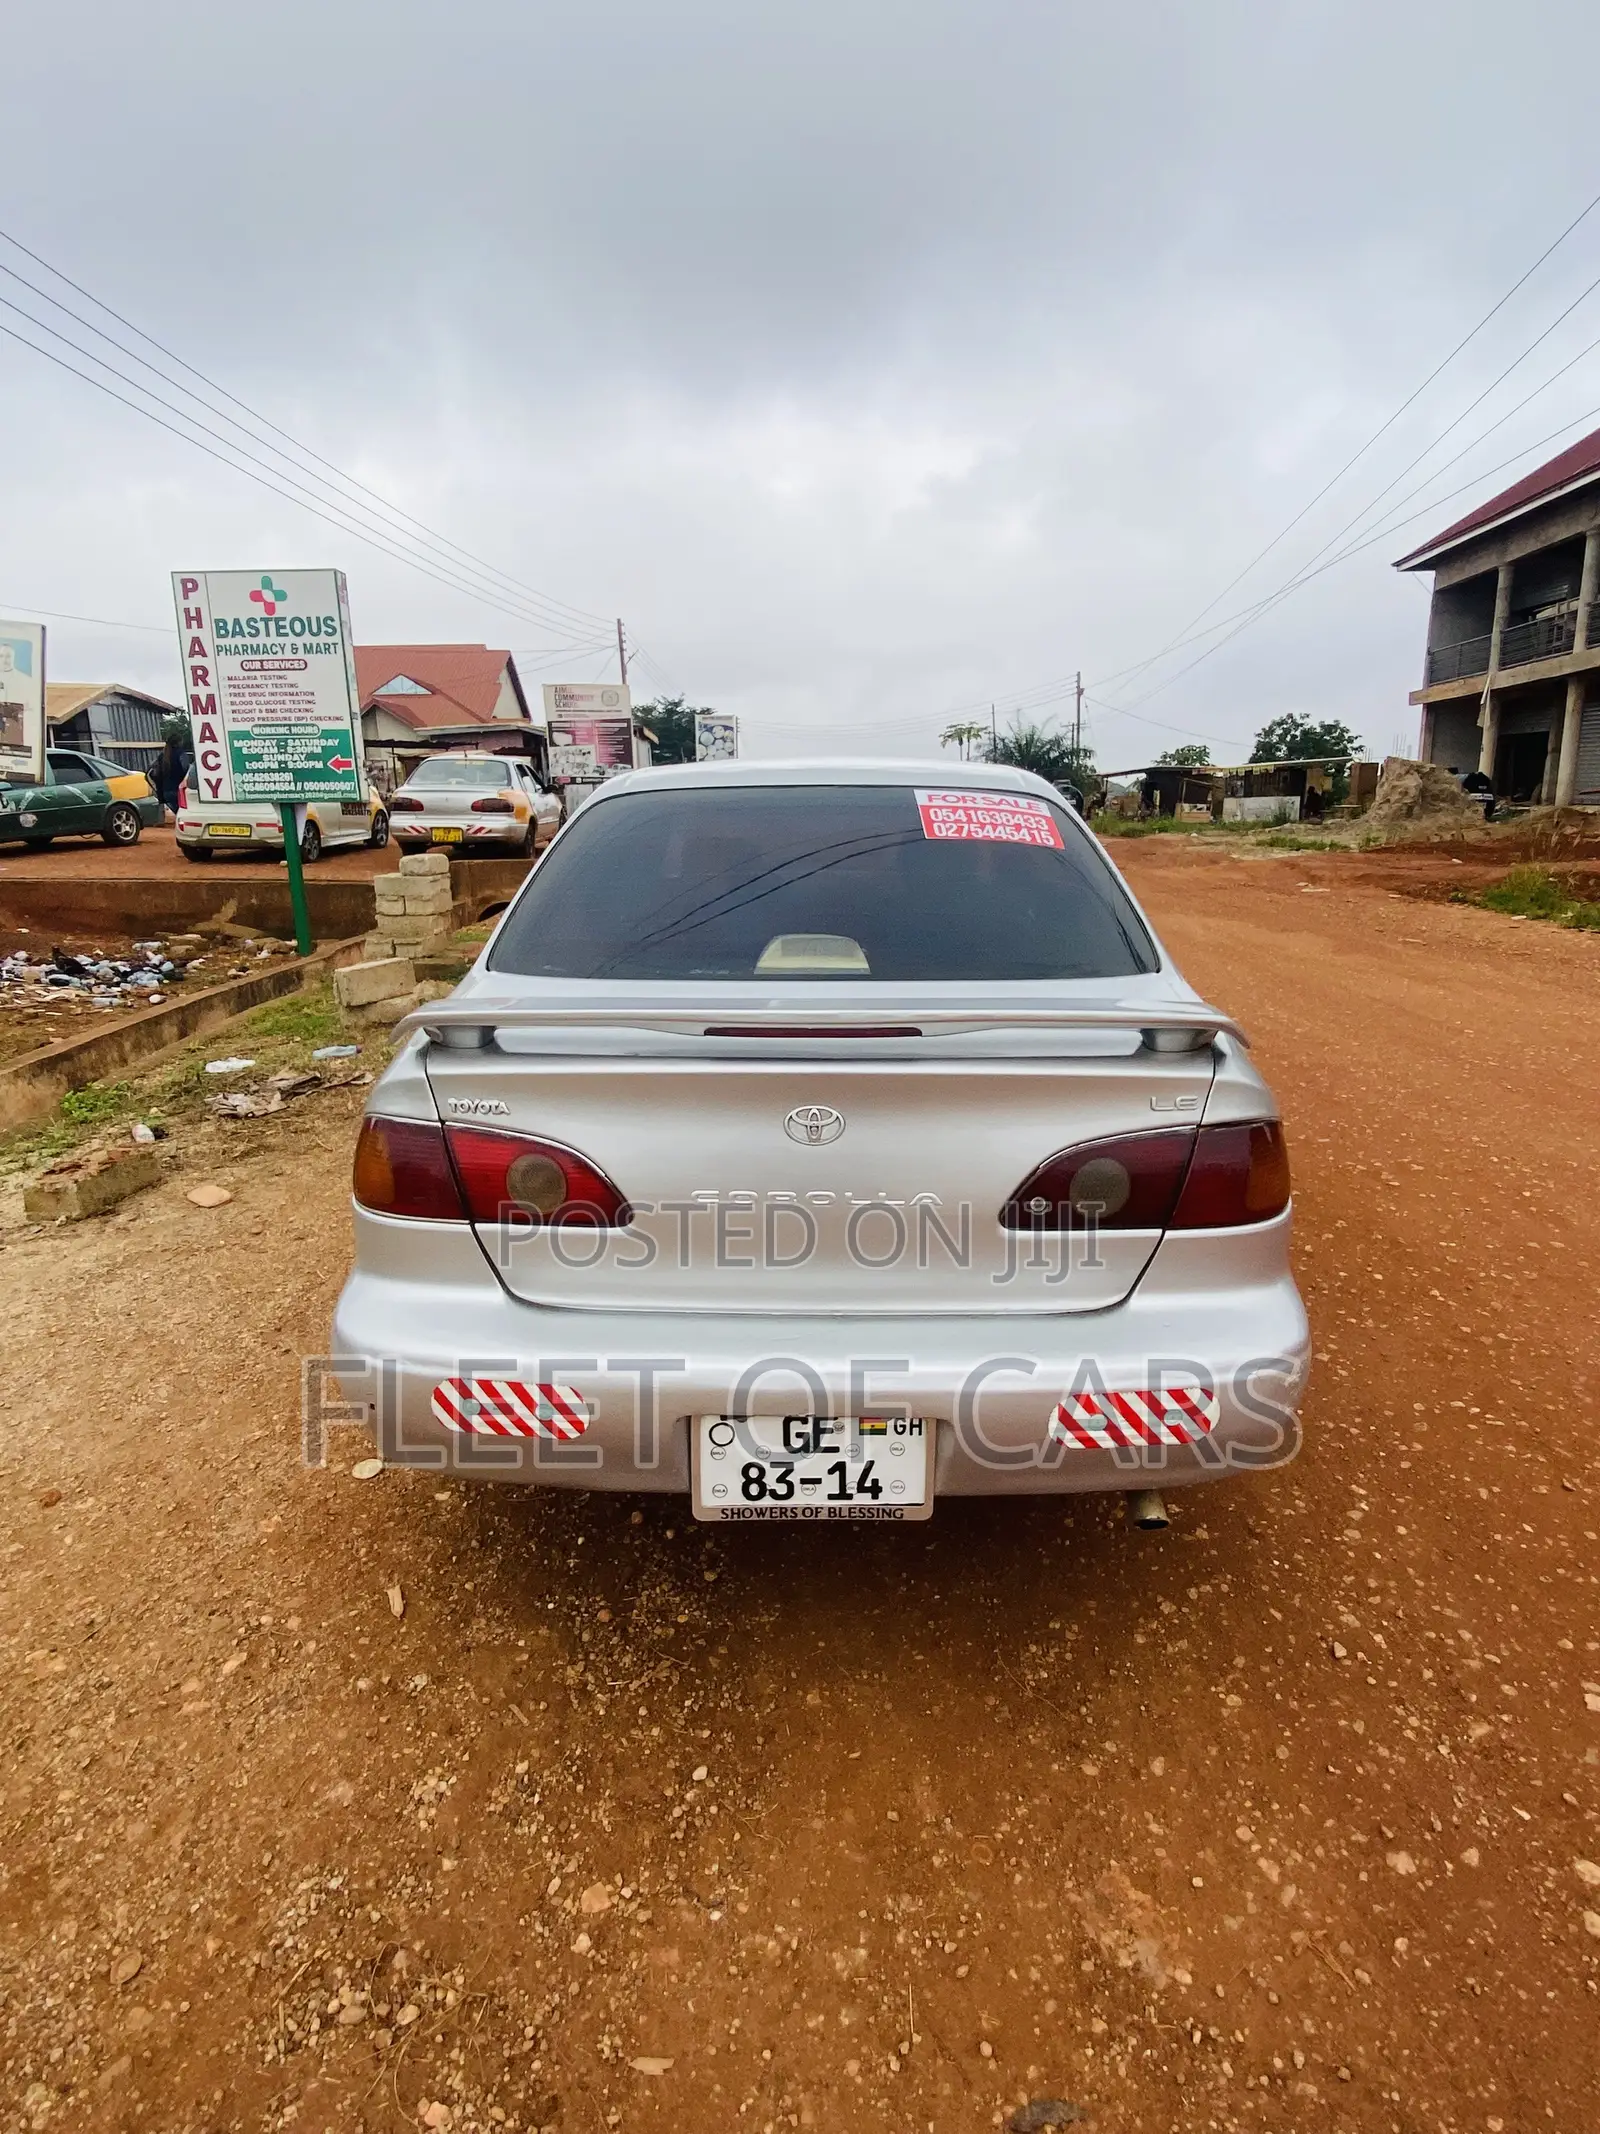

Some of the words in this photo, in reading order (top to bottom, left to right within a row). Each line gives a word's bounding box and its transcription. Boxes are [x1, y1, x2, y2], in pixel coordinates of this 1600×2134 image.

[214, 616, 338, 639] BASTEOUS
[216, 643, 287, 657] PHARMACY
[290, 643, 299, 655] &
[303, 642, 339, 655] MART
[242, 660, 261, 670] OUR
[262, 659, 306, 670] SERVICES
[180, 577, 223, 799] PHARMACY
[252, 725, 290, 735] WORKING
[291, 725, 319, 734] HOURS
[233, 740, 278, 748] MONDAY
[287, 738, 340, 747] SATURDAY
[926, 794, 977, 805] FOR
[979, 797, 1042, 811] SALE
[928, 807, 1050, 832] 0541638433
[932, 822, 1056, 847] 0275445415
[447, 1097, 511, 1115] TOYOTA
[1150, 1095, 1199, 1112] LE
[782, 1416, 841, 1454] GE
[893, 1417, 923, 1436] GH
[740, 1459, 884, 1502] 83-14
[720, 1506, 798, 1520] SHOWERS
[802, 1506, 823, 1519] OF
[826, 1506, 905, 1520] BLESSING
